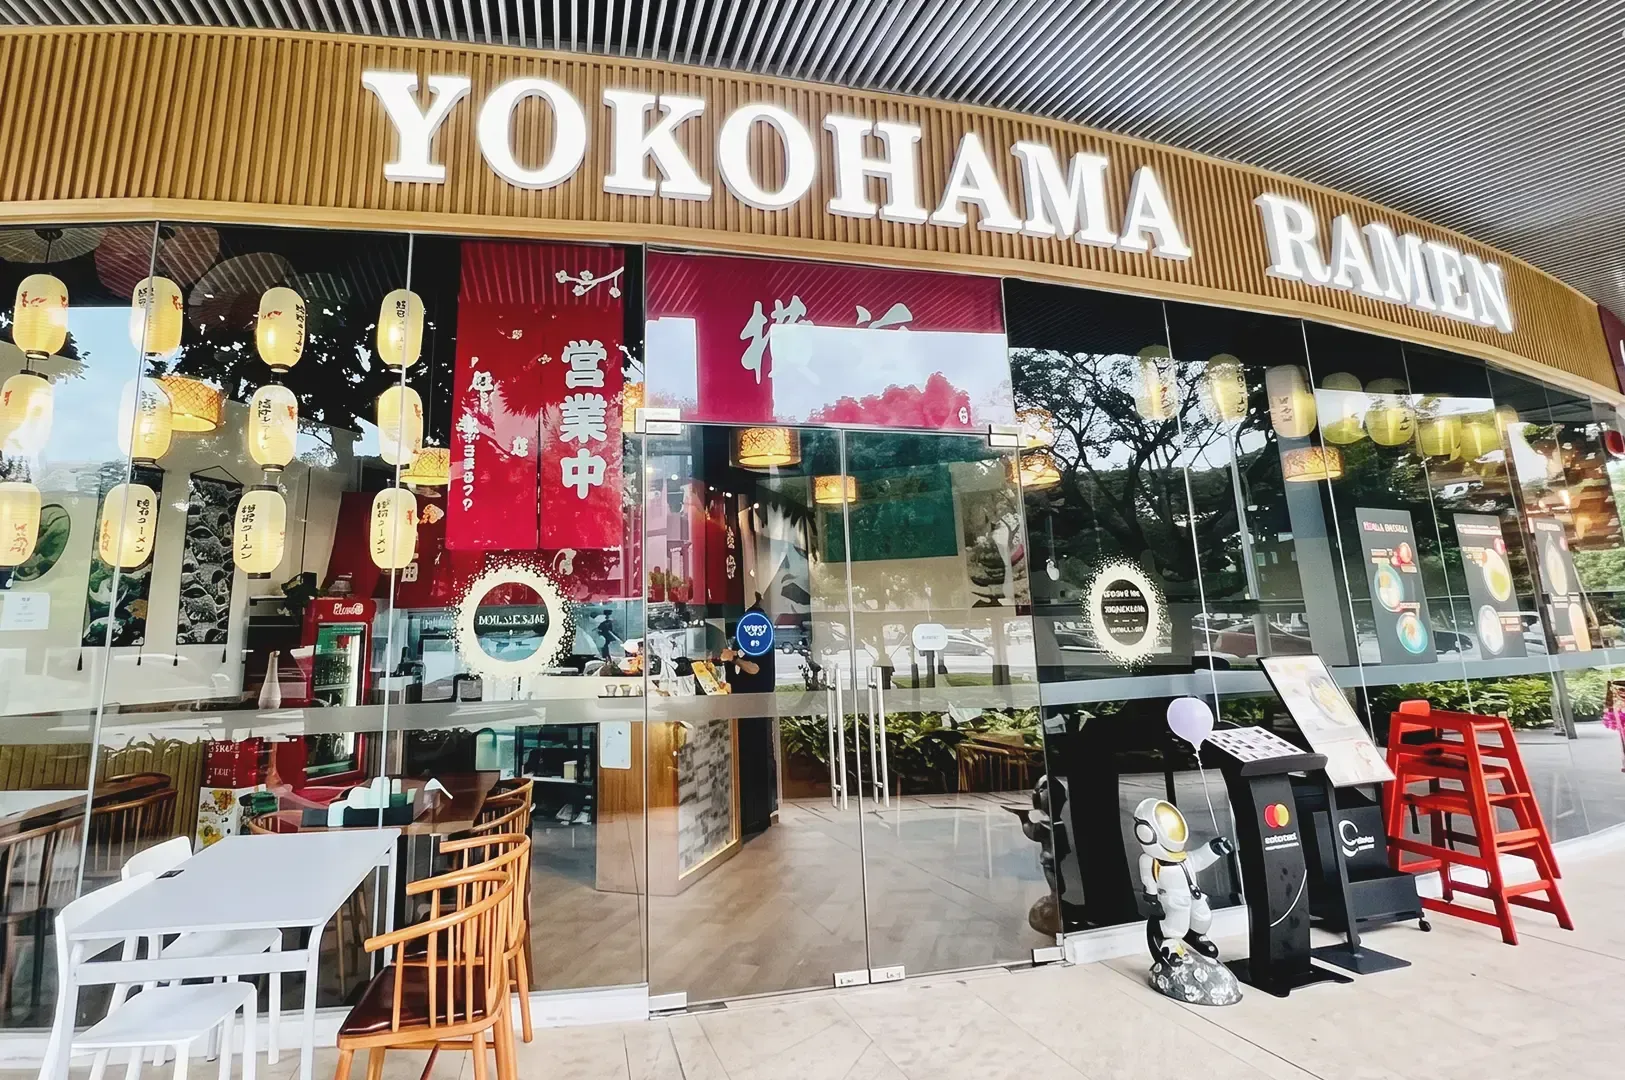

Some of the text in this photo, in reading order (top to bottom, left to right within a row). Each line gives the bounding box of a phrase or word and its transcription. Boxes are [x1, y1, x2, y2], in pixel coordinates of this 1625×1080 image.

[361, 70, 1514, 333] YOKOHAMA RAMEN
[560, 339, 608, 500] 営業中
